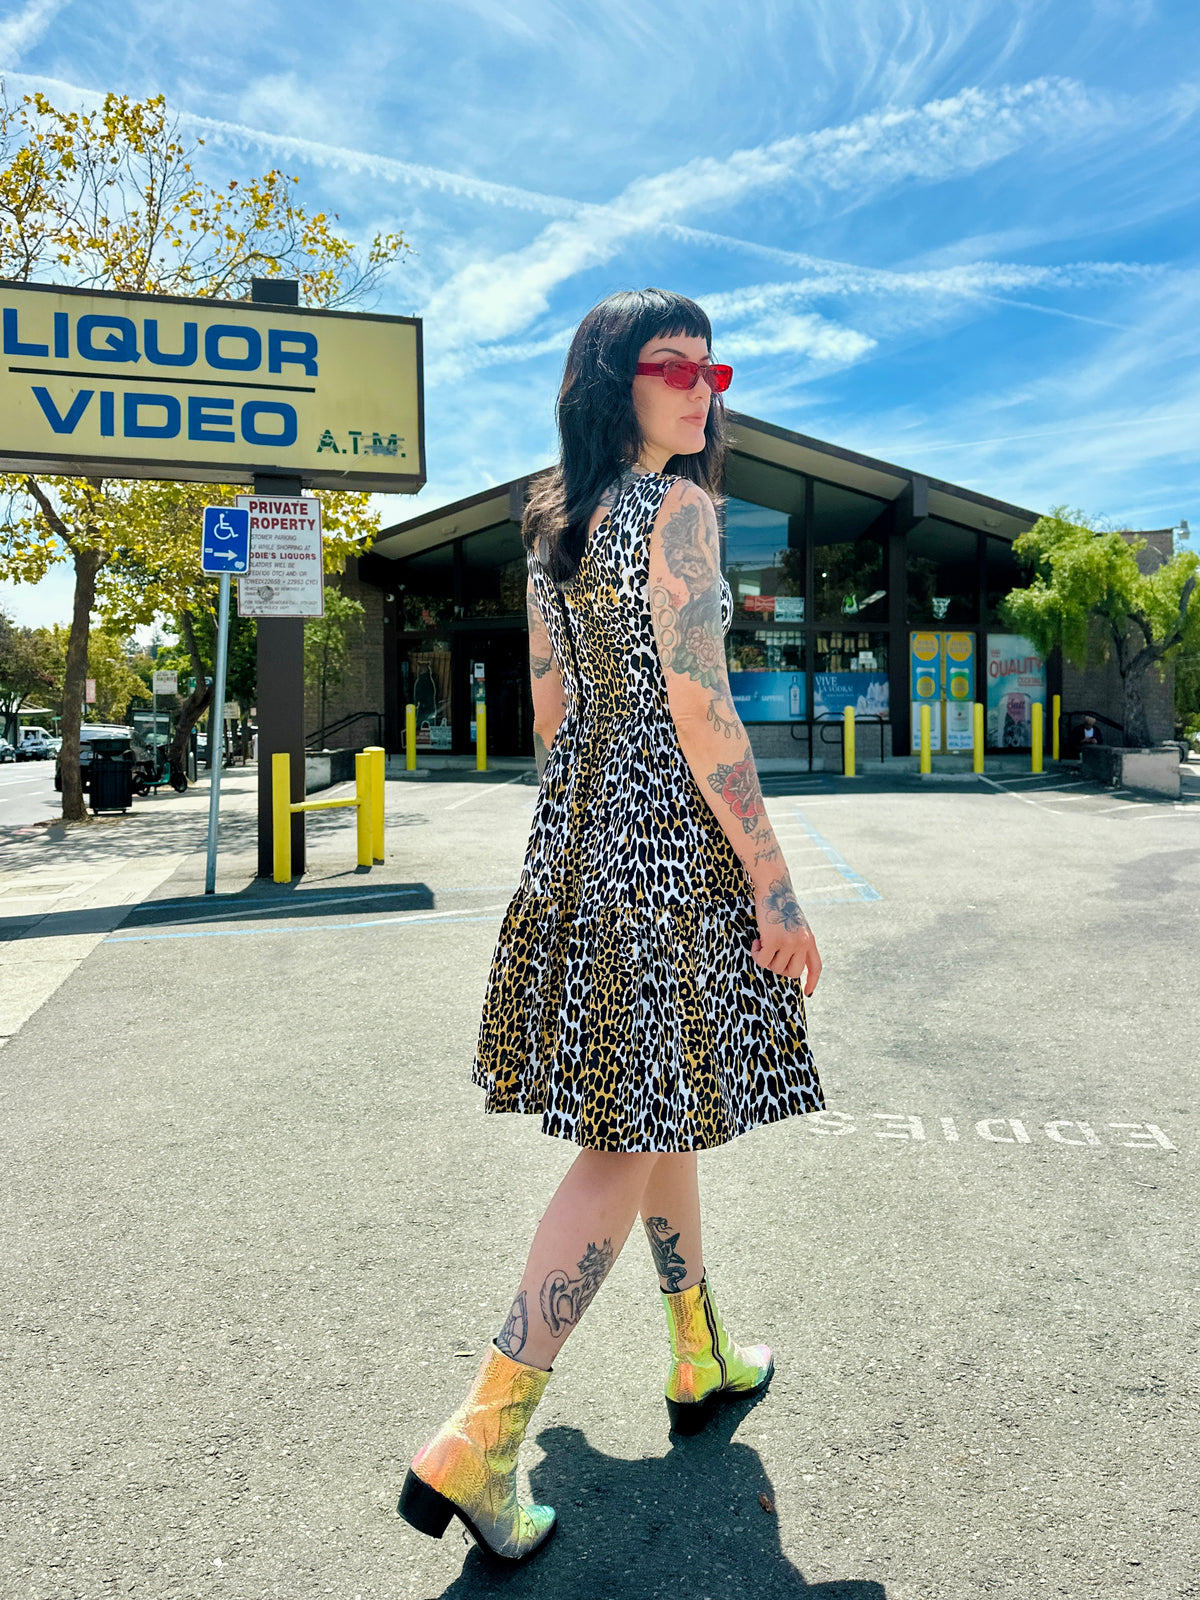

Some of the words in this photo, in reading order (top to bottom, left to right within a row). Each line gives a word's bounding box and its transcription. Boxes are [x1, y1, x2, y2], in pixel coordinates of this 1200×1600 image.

[3, 308, 319, 377] LIQUOR
[31, 386, 298, 448] VIDEO
[316, 429, 406, 458] A.T.M.
[249, 501, 308, 515] PRIVATE
[251, 517, 316, 531] ROPERTY
[274, 534, 297, 542] PARKING
[249, 551, 277, 560] DDIE'S
[279, 552, 317, 561] LIQUORS
[989, 656, 1043, 679] QUALITY
[815, 675, 838, 686] VIVE
